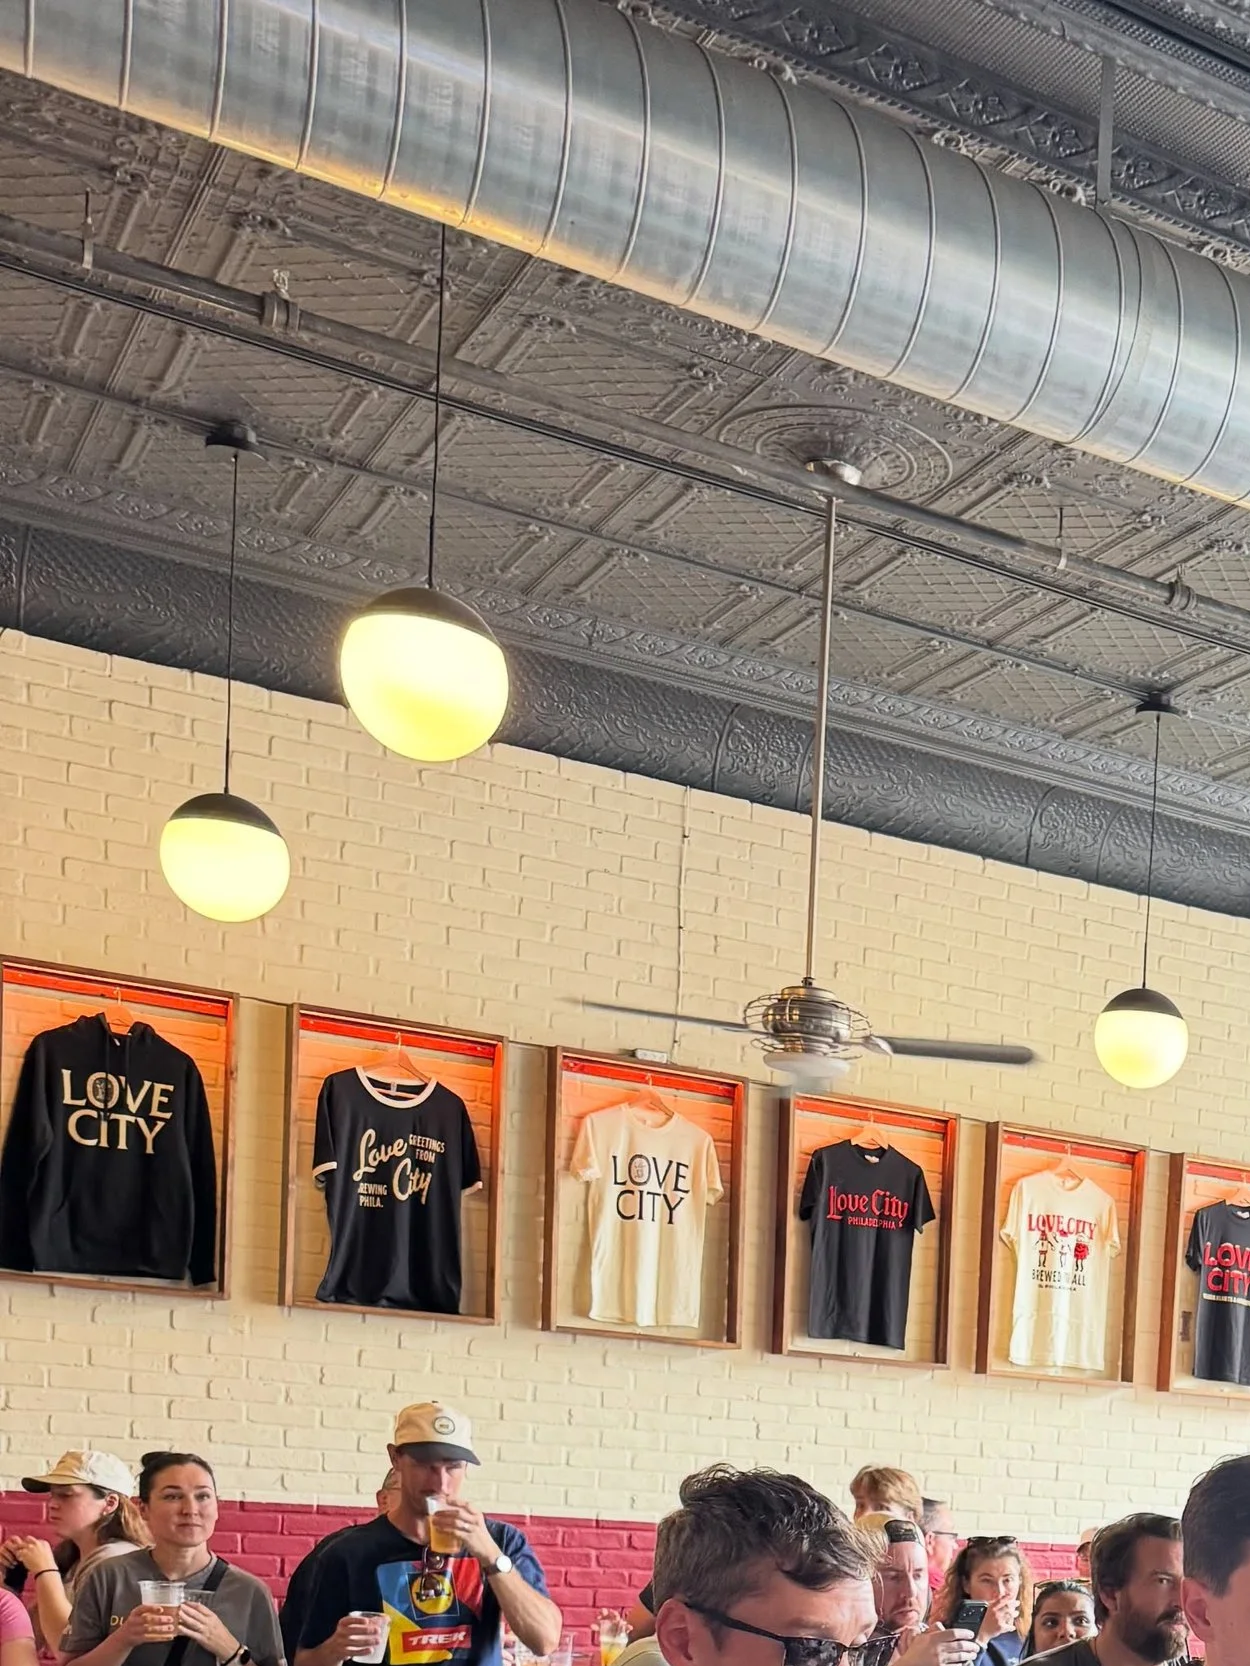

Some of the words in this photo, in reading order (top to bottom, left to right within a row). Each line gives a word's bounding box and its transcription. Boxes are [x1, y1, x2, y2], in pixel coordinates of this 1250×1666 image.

[61, 1068, 175, 1120] LOVE
[67, 1109, 166, 1154] CITY
[409, 1133, 446, 1153] GREETINGS
[352, 1128, 408, 1182] Love
[415, 1148, 436, 1163] FROM
[392, 1157, 433, 1205] City
[612, 1154, 690, 1194] LOVE
[359, 1195, 384, 1208] PHILA.
[616, 1189, 685, 1225] CITY
[826, 1185, 869, 1220] Love
[871, 1188, 909, 1228] City
[847, 1216, 897, 1230] PHILADELPHIA
[1028, 1213, 1065, 1233] LOVE
[1067, 1217, 1097, 1240] CITY
[408, 1631, 467, 1646] TREK
